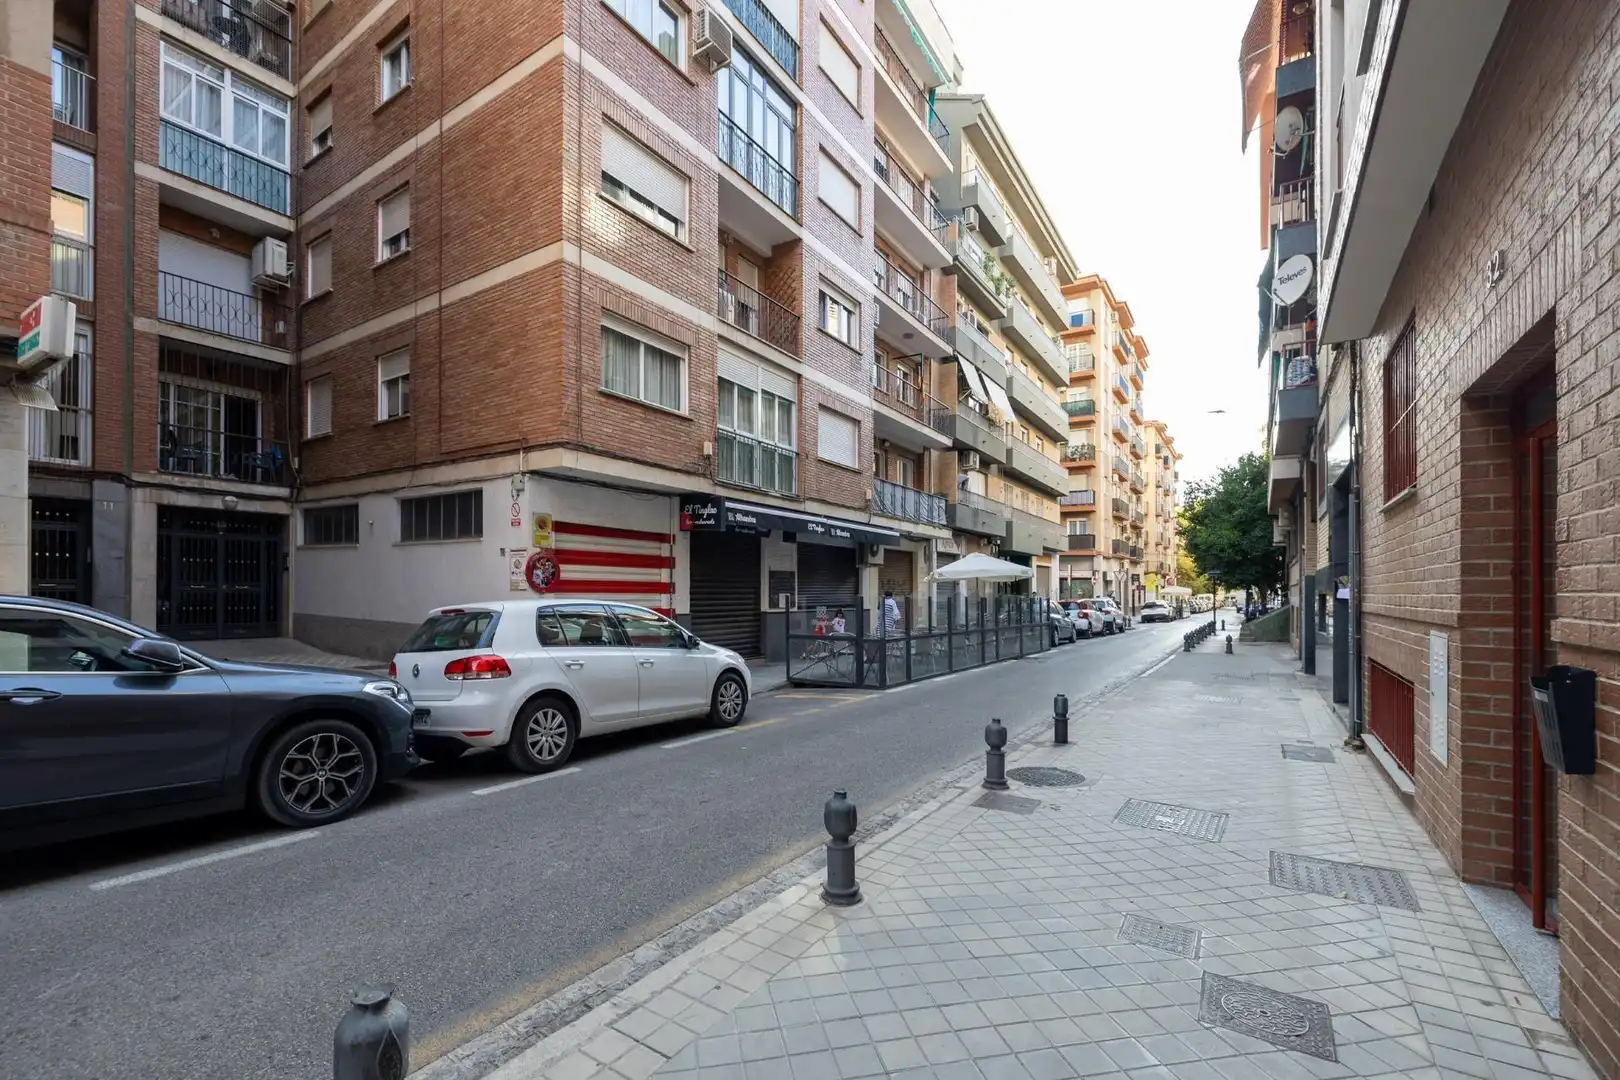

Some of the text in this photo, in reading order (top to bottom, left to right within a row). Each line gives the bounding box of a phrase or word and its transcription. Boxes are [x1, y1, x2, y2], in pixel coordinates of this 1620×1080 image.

[1277, 266, 1307, 285] Televes
[1486, 250, 1500, 289] 32
[102, 501, 114, 510] 11
